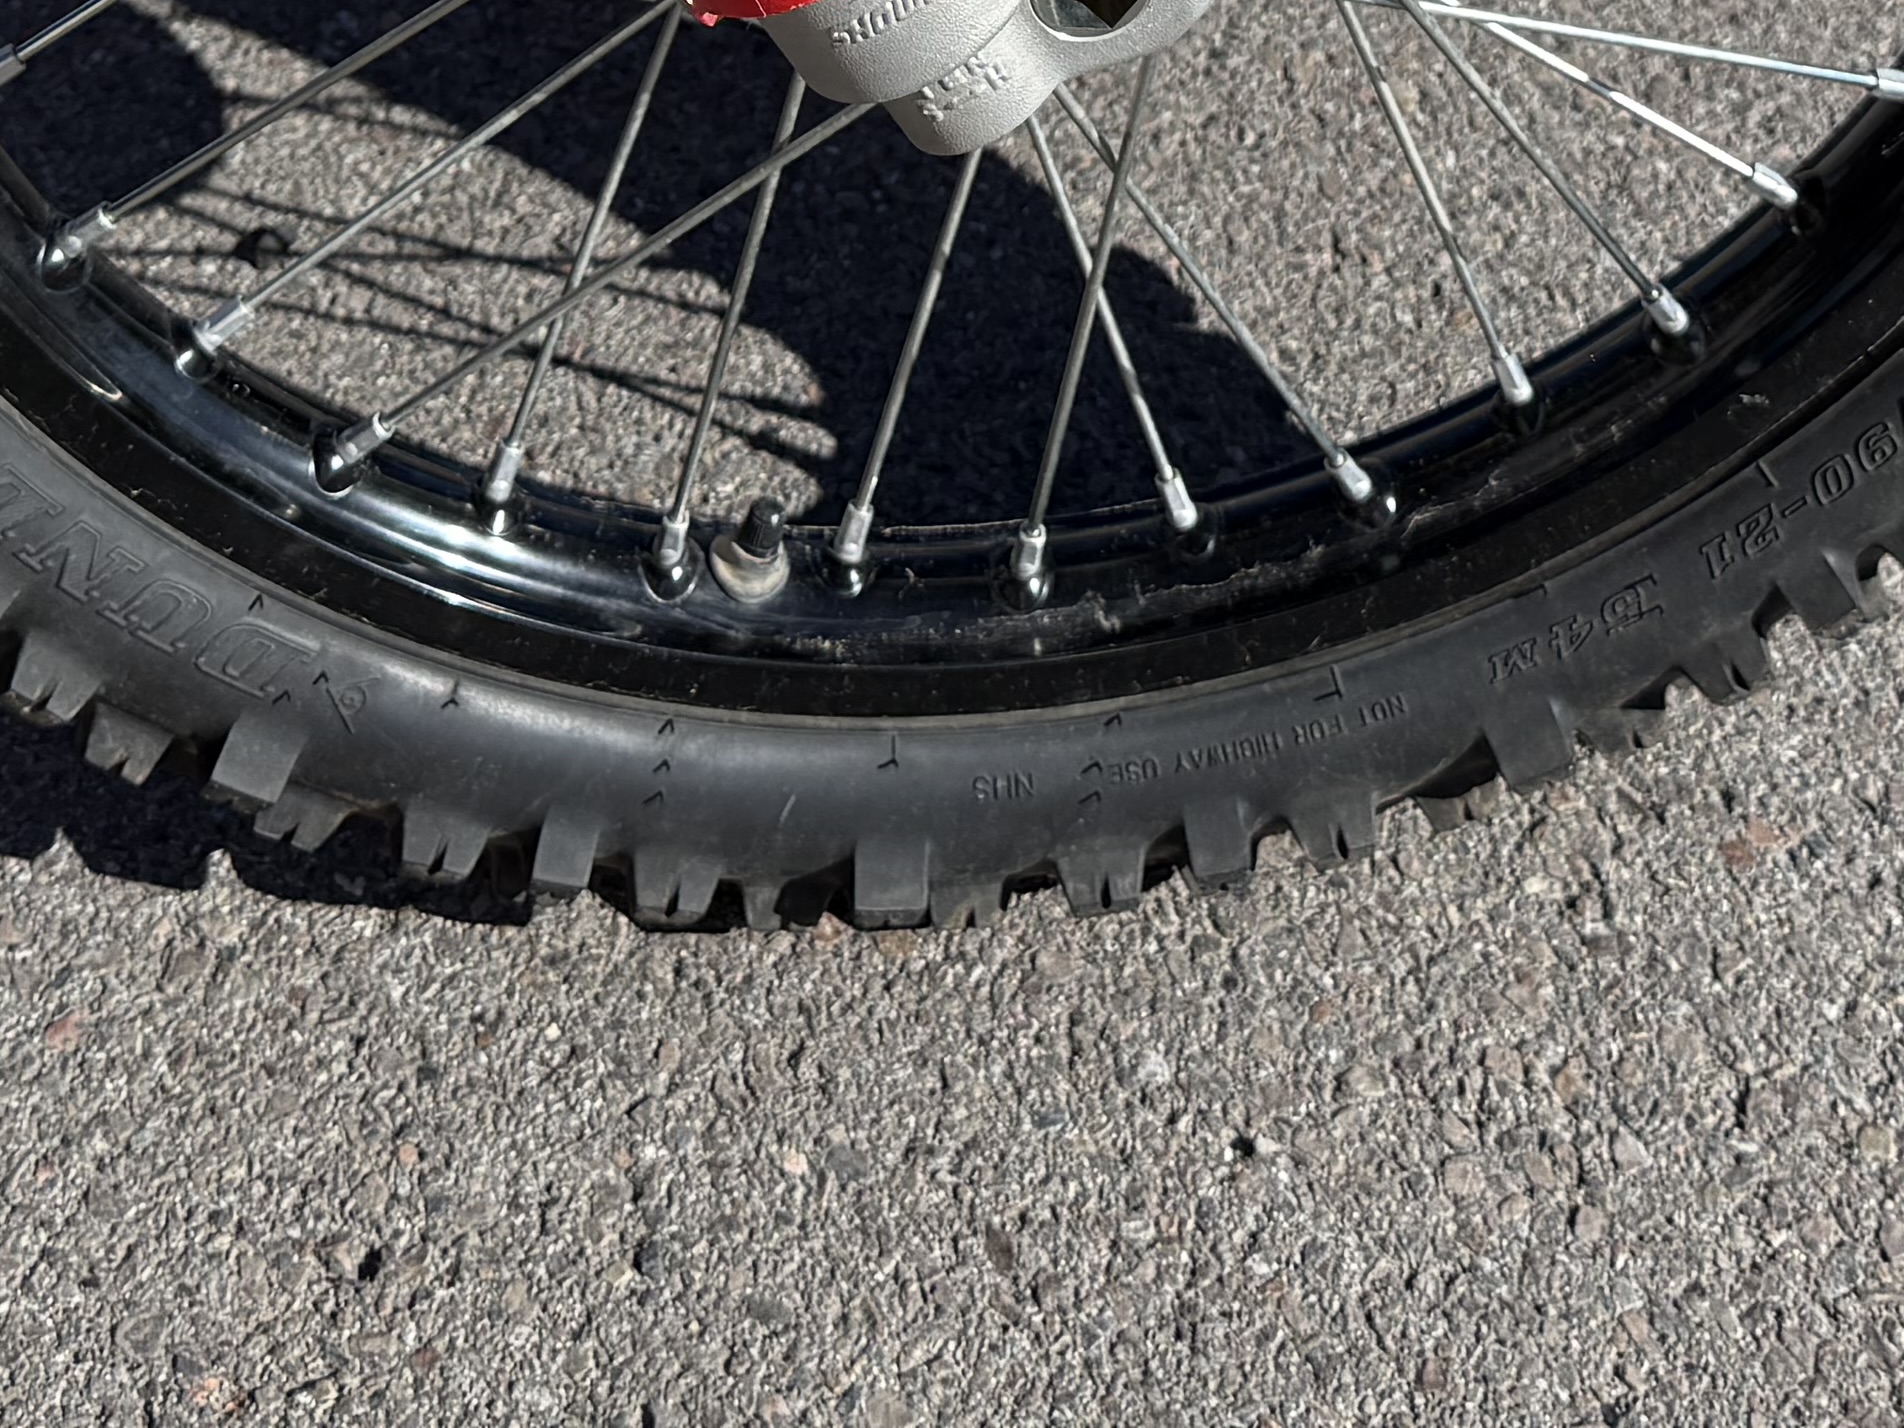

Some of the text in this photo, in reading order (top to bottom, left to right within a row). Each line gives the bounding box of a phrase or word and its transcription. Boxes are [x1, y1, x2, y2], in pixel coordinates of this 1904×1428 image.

[1107, 693, 1409, 784] NOT FOR HIGHWAY USE
[971, 771, 1035, 801] NHS
